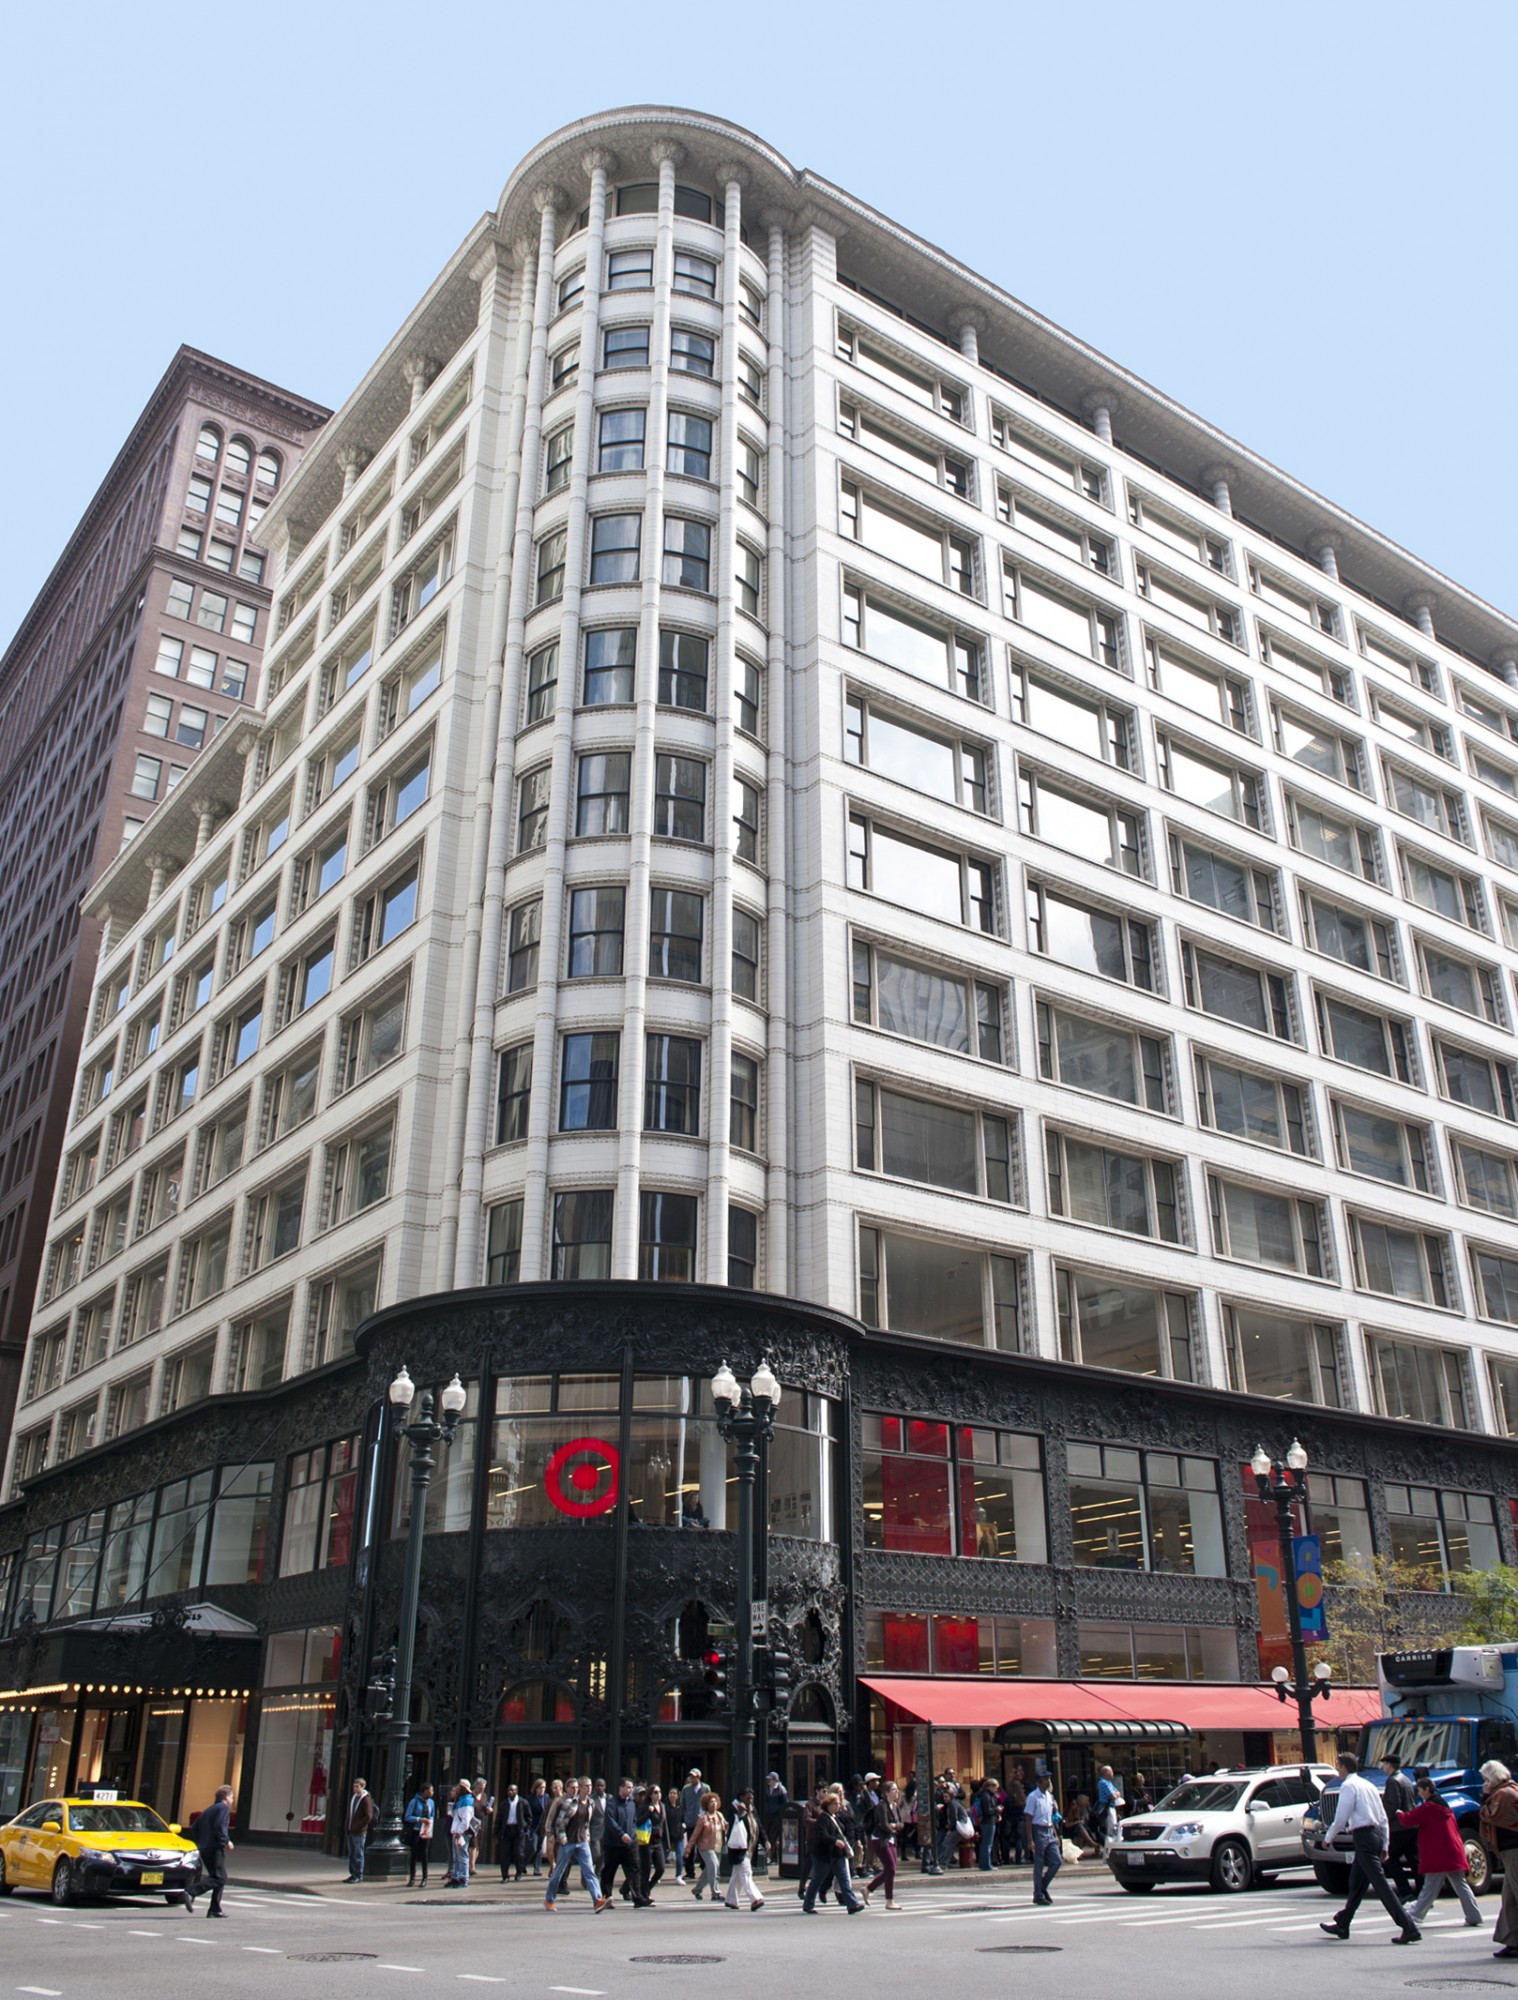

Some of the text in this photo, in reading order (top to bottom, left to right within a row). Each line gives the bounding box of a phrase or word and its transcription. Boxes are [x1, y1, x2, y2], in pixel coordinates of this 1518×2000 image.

[752, 1602, 766, 1613] ONE
[752, 1613, 766, 1622] WAY
[1395, 1653, 1432, 1662] CARRIER
[96, 1792, 113, 1800] 4271
